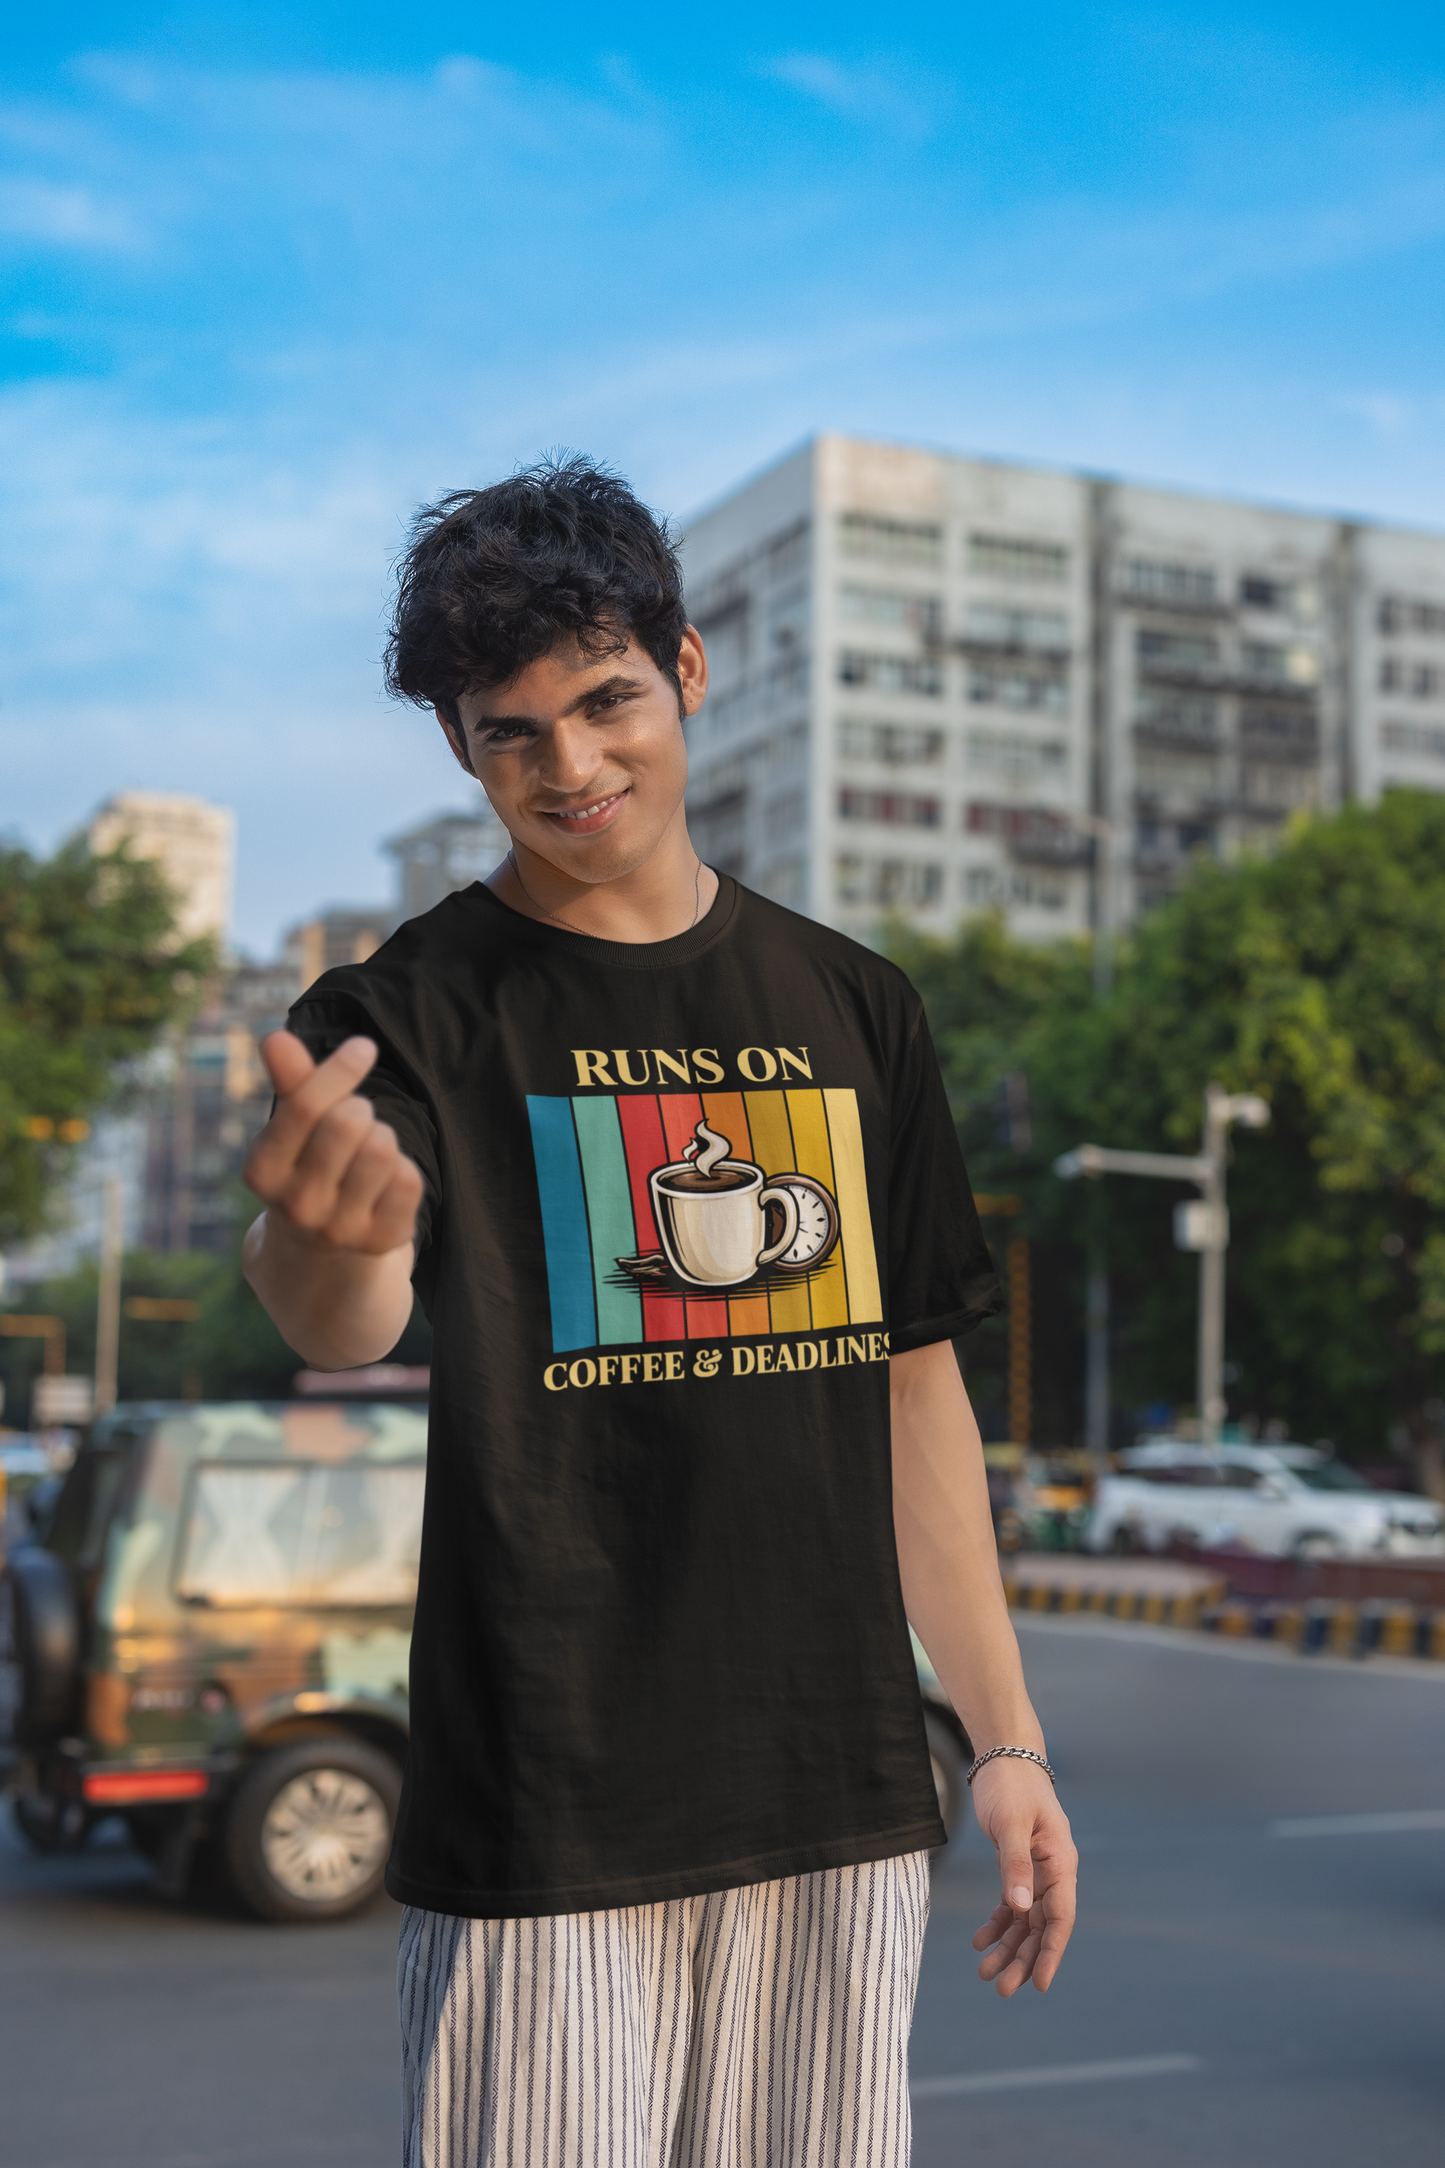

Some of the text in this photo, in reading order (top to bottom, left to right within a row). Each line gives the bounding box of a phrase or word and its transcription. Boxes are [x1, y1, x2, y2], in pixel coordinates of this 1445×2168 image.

[571, 1047, 813, 1086] RUNS ON
[543, 1351, 685, 1391] COFFEE
[693, 1349, 723, 1378] &
